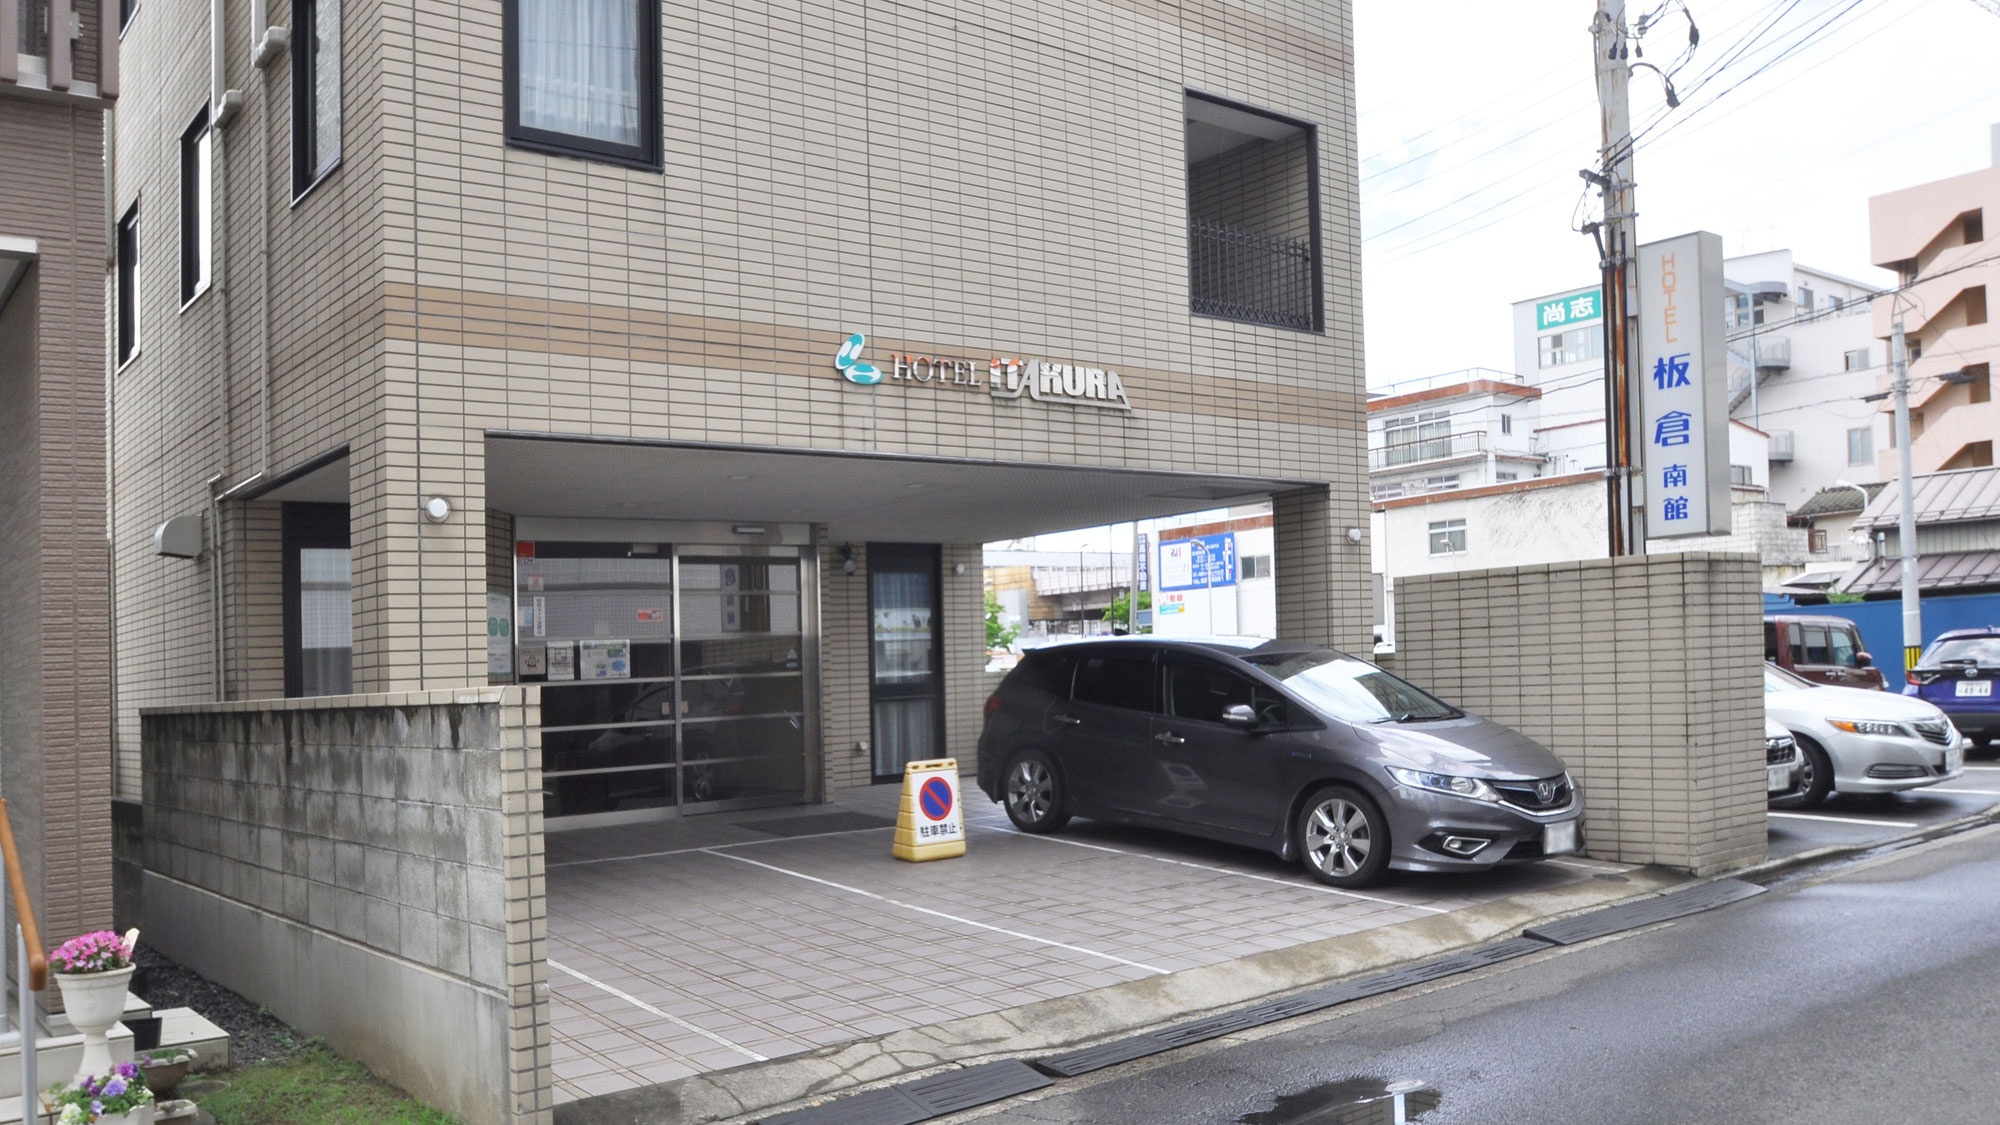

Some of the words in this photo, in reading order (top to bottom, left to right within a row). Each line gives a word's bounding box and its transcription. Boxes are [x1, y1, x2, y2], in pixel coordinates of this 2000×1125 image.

[1542, 296, 1594, 326] 尚志
[1661, 252, 1678, 344] HOTEL
[891, 353, 983, 387] HOTEL
[989, 357, 1132, 410] ITAKURA
[1653, 352, 1692, 521] 板倉南館
[920, 822, 957, 838] 駐車禁止
